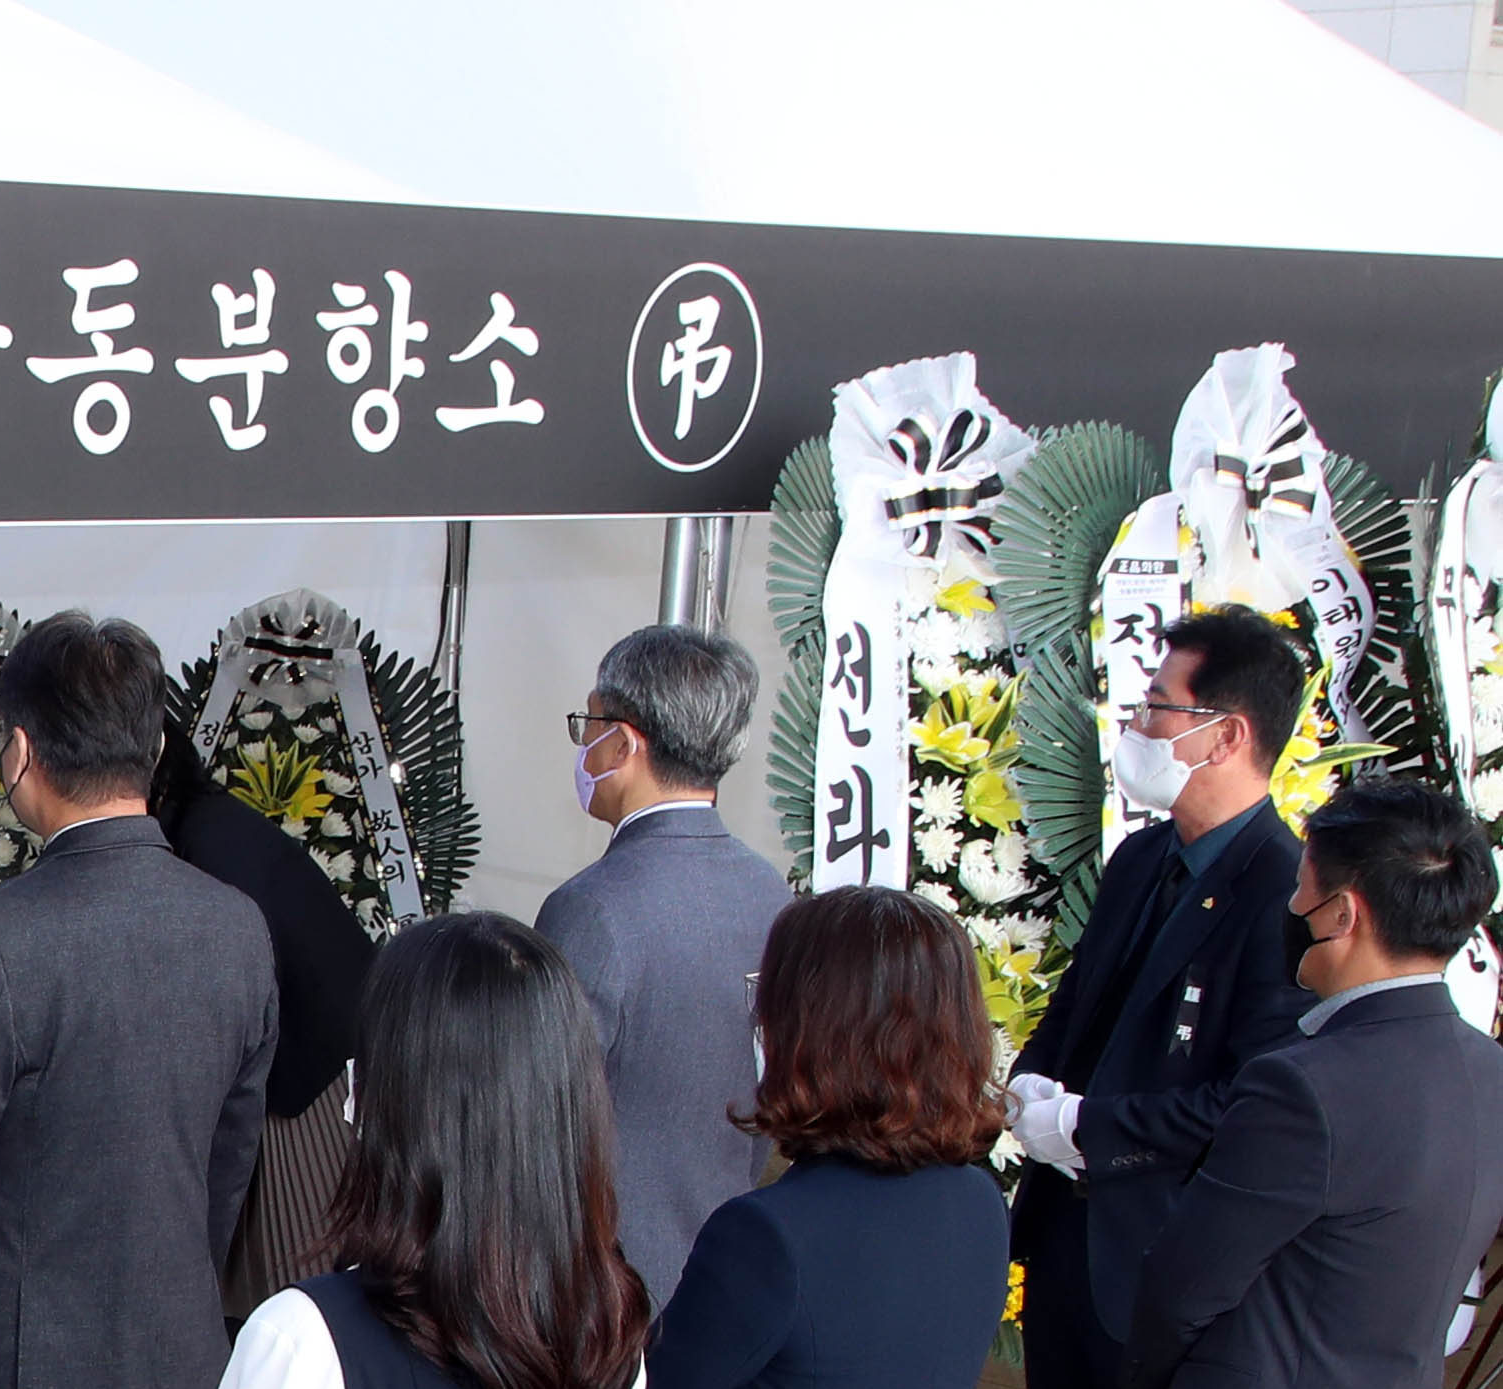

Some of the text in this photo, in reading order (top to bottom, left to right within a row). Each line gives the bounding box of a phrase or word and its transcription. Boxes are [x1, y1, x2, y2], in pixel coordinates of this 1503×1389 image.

[660, 295, 732, 440] 弔
[350, 730, 384, 779] 삼가
[372, 808, 408, 885] 故人의
